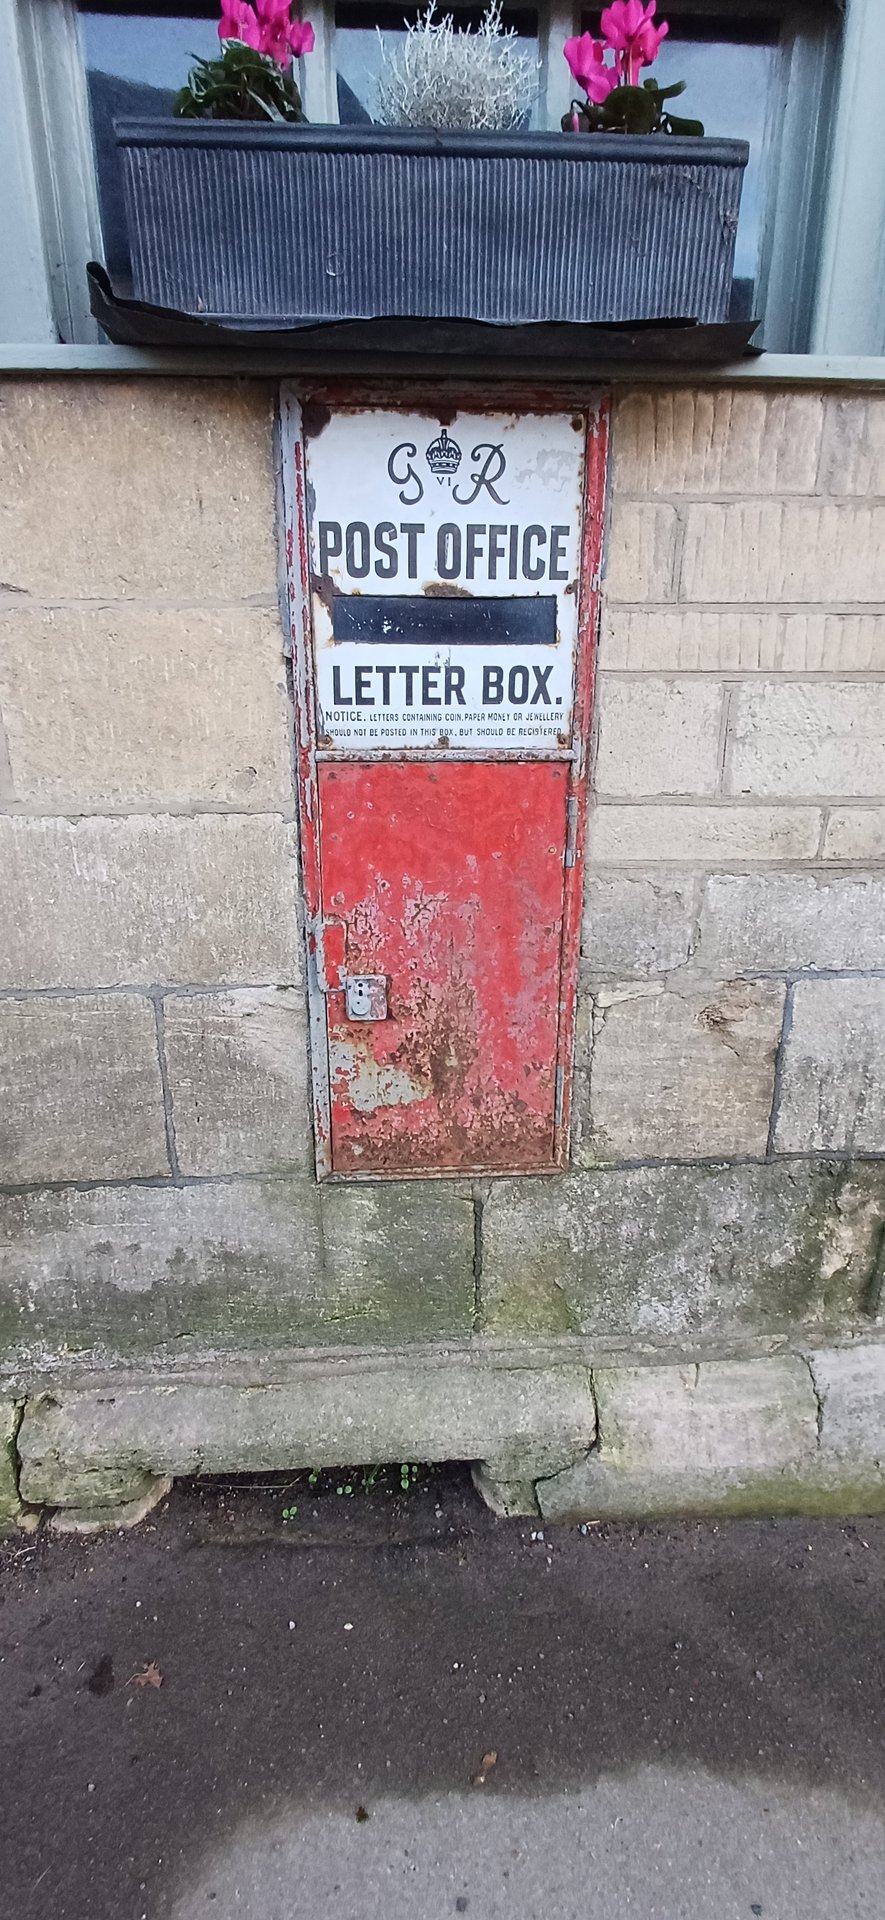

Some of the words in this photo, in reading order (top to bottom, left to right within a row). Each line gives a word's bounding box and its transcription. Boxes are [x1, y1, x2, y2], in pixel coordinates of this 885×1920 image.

[387, 442, 424, 505] G
[436, 476, 451, 486] VI
[452, 443, 511, 505] R
[318, 521, 425, 579] POST
[436, 522, 571, 581] OFFICE
[332, 665, 467, 706] LETTER
[481, 665, 562, 705] BOX.
[325, 711, 366, 722] NOTICE.
[369, 713, 399, 722] LETTERS
[402, 713, 442, 722] CONTAINING
[487, 712, 510, 722] MONEY
[513, 712, 523, 721] OR
[525, 712, 564, 721] JEWELLERY
[325, 728, 351, 737] SHOULD
[353, 728, 367, 737] NOT
[369, 728, 378, 737] BE
[380, 728, 407, 737] POSTED
[410, 728, 418, 737] IN
[420, 728, 437, 737] THIS
[459, 728, 473, 736] BUT
[476, 727, 503, 736] SHOULD
[506, 727, 516, 736] BE
